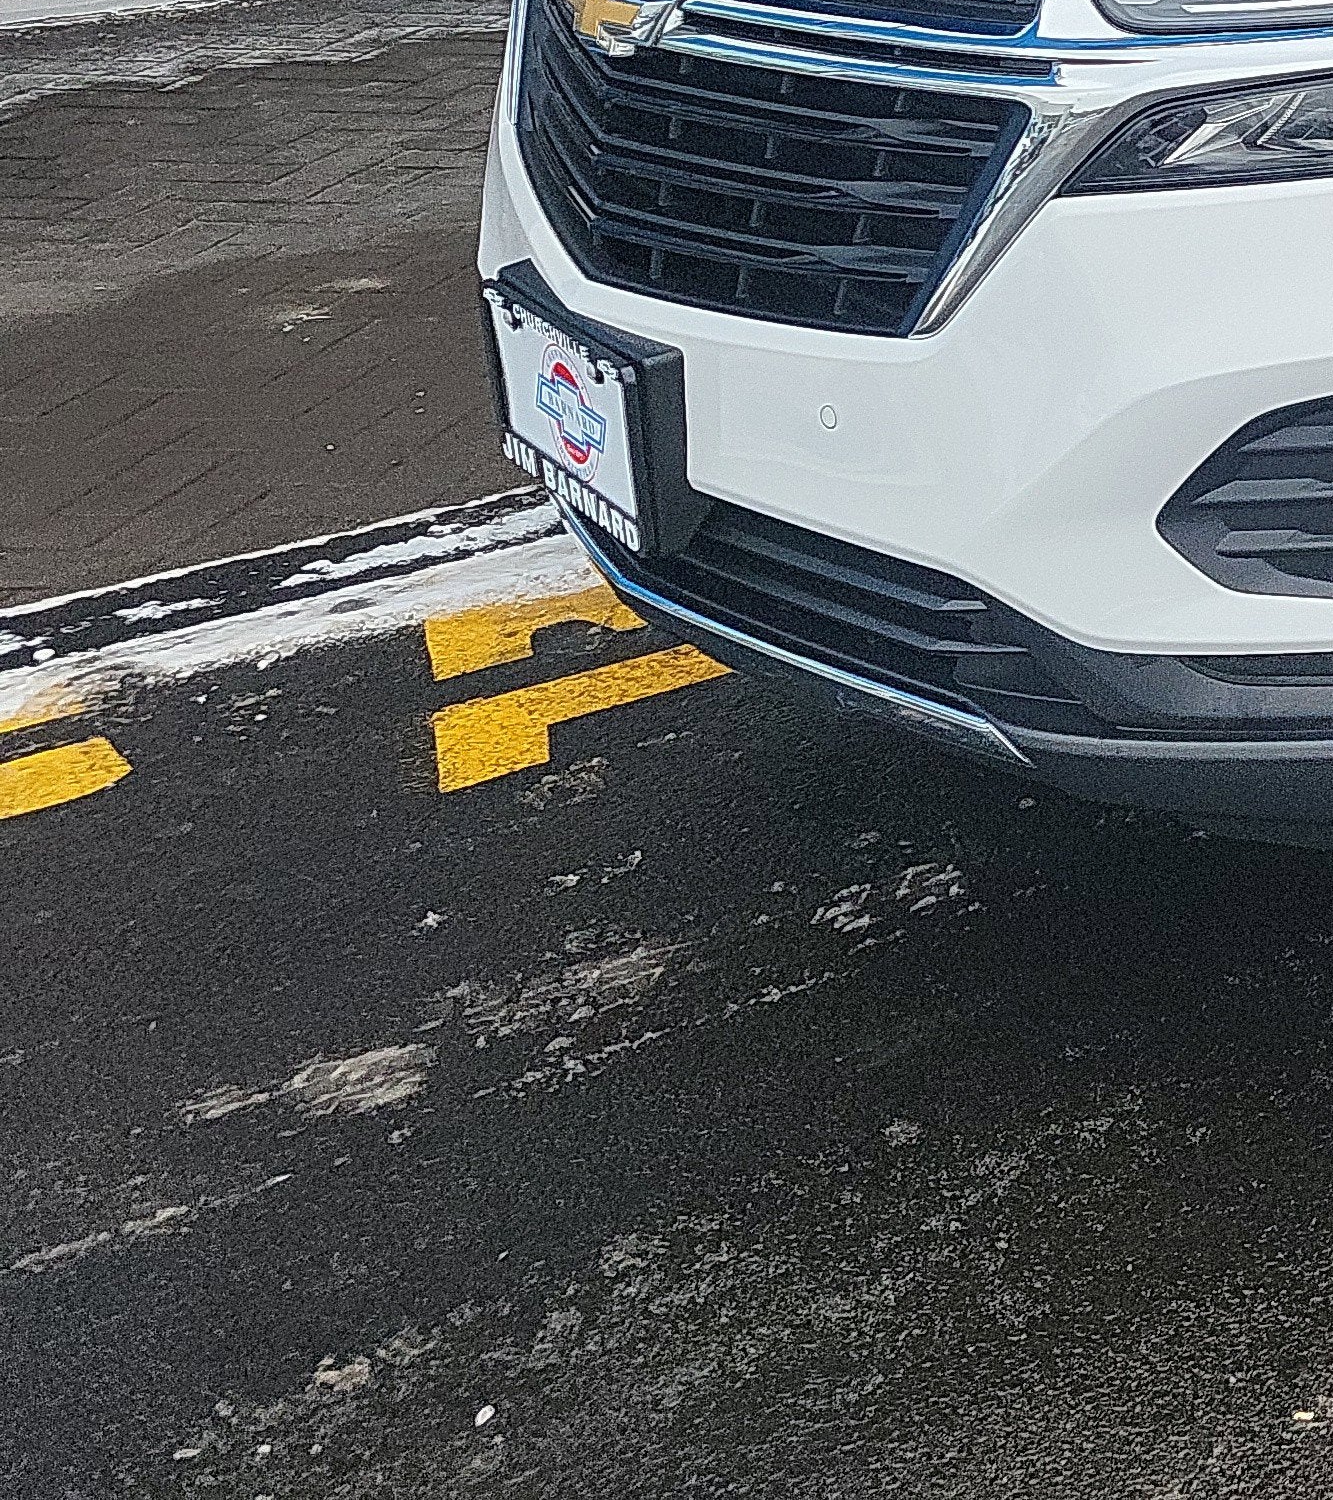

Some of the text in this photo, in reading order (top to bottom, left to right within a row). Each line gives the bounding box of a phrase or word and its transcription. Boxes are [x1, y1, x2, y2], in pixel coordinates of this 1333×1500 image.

[511, 302, 592, 362] CHURCHVILLE
[502, 432, 539, 479] JIM
[541, 461, 642, 553] BARNARD
